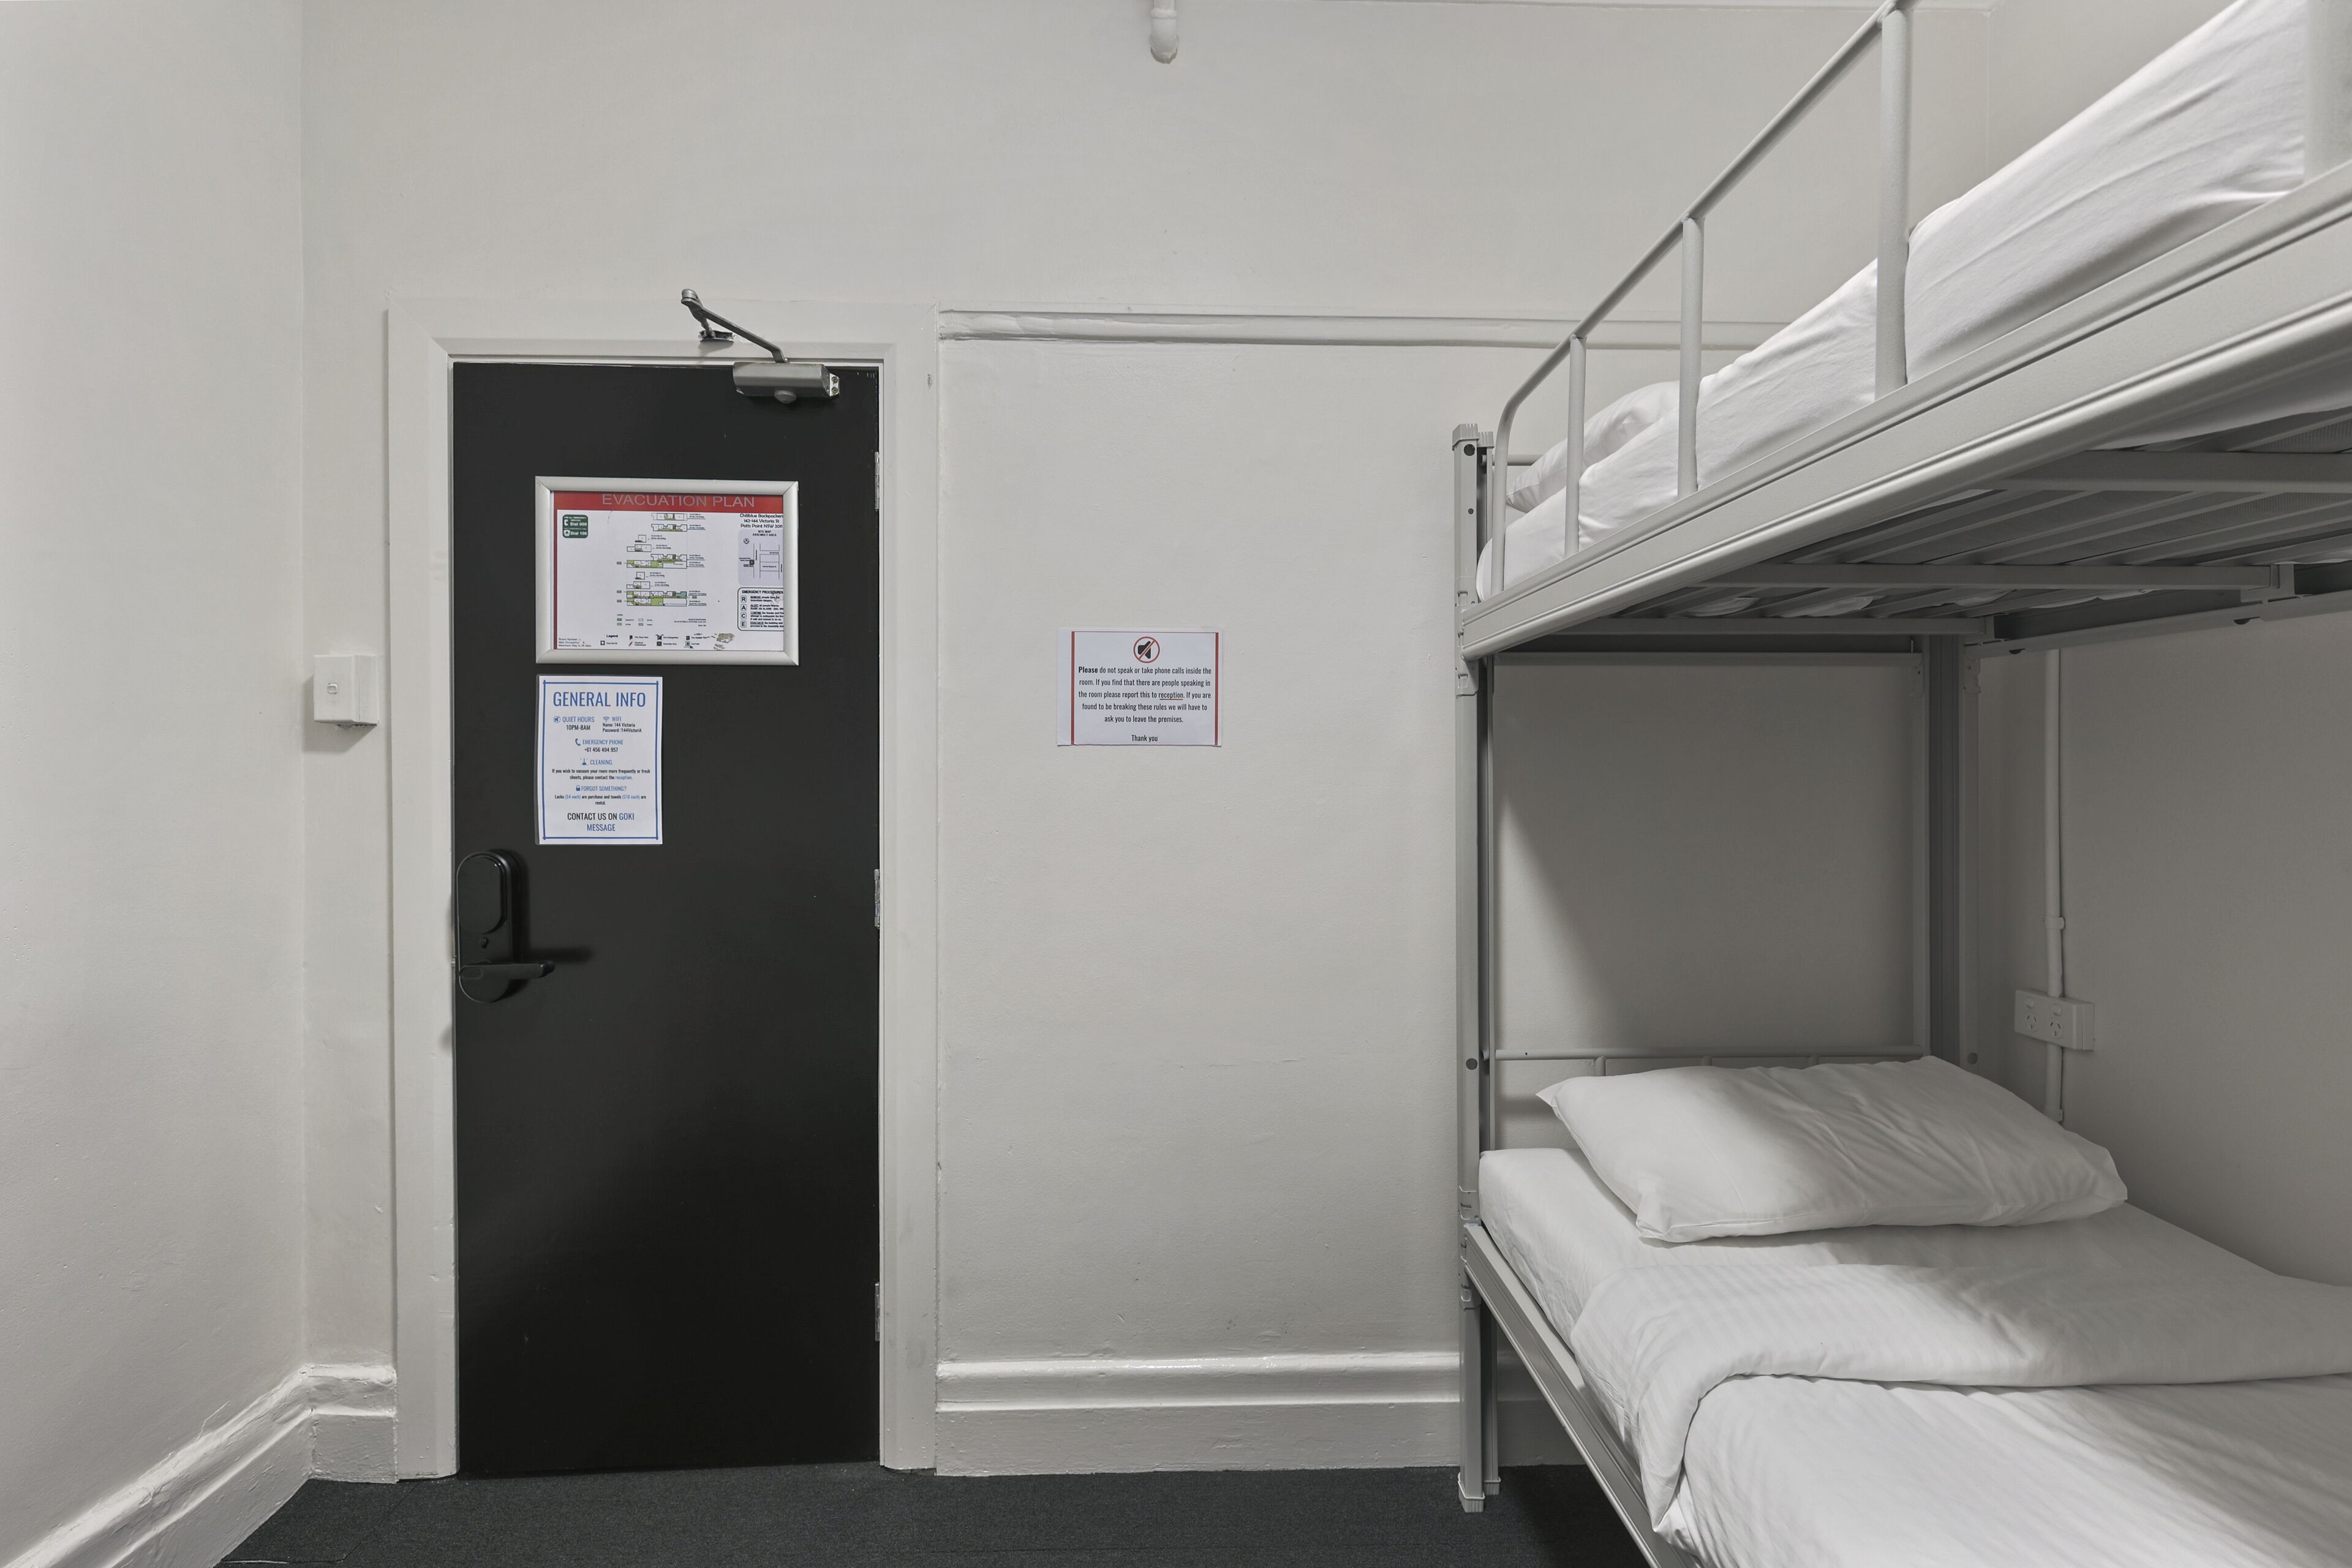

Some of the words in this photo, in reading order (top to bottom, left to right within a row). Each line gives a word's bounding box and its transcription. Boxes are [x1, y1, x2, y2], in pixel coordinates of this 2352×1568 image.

[602, 494, 707, 507] EVACUATION
[713, 496, 755, 507] PLAN
[554, 692, 611, 706] GENERAL
[616, 692, 646, 707] INFO
[1159, 692, 1185, 700] reception.
